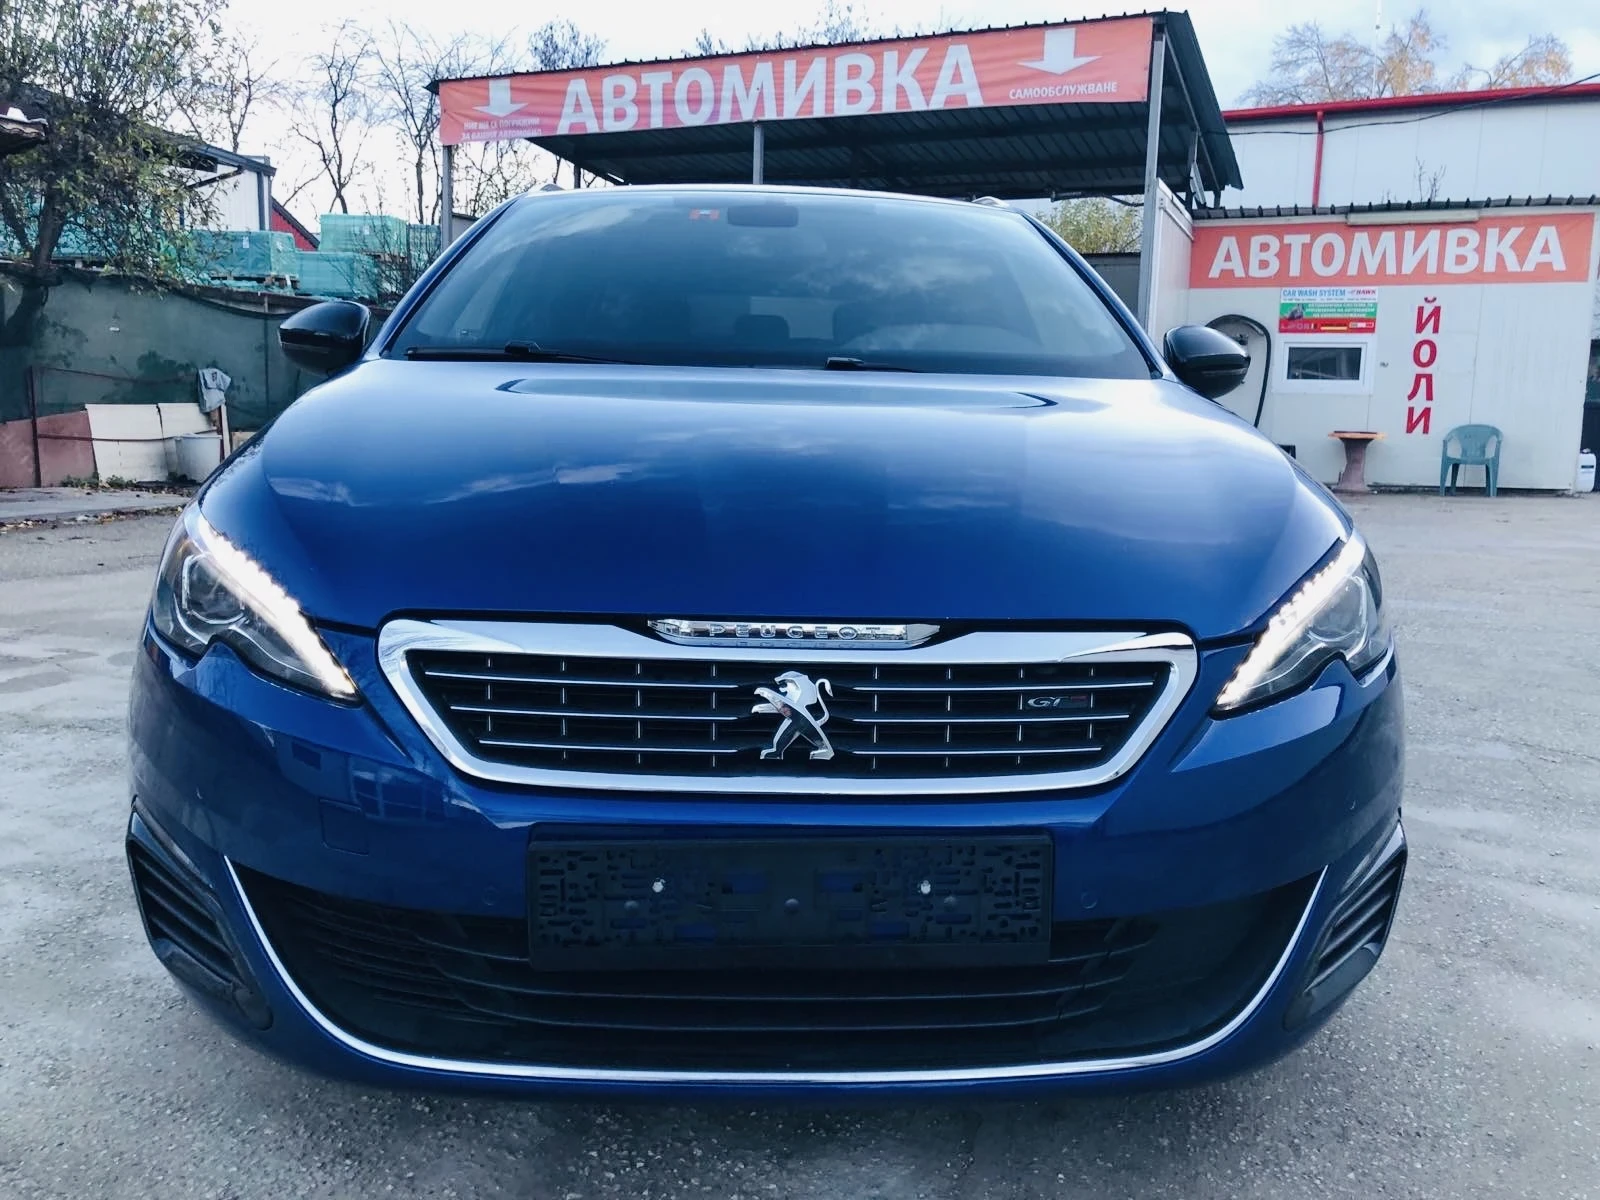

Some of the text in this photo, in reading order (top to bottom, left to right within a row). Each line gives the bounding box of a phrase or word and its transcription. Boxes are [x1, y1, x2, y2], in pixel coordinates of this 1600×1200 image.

[557, 43, 984, 136] АВТОМИВКА
[1008, 81, 1118, 100] САМООБСЛУЖВАНЕ
[1208, 225, 1567, 279] АВТОМИВКА
[1282, 288, 1346, 297] CAR WASH SYSTEM
[1406, 296, 1441, 435] ЙОЛИ
[708, 624, 882, 639] PEUGEOT
